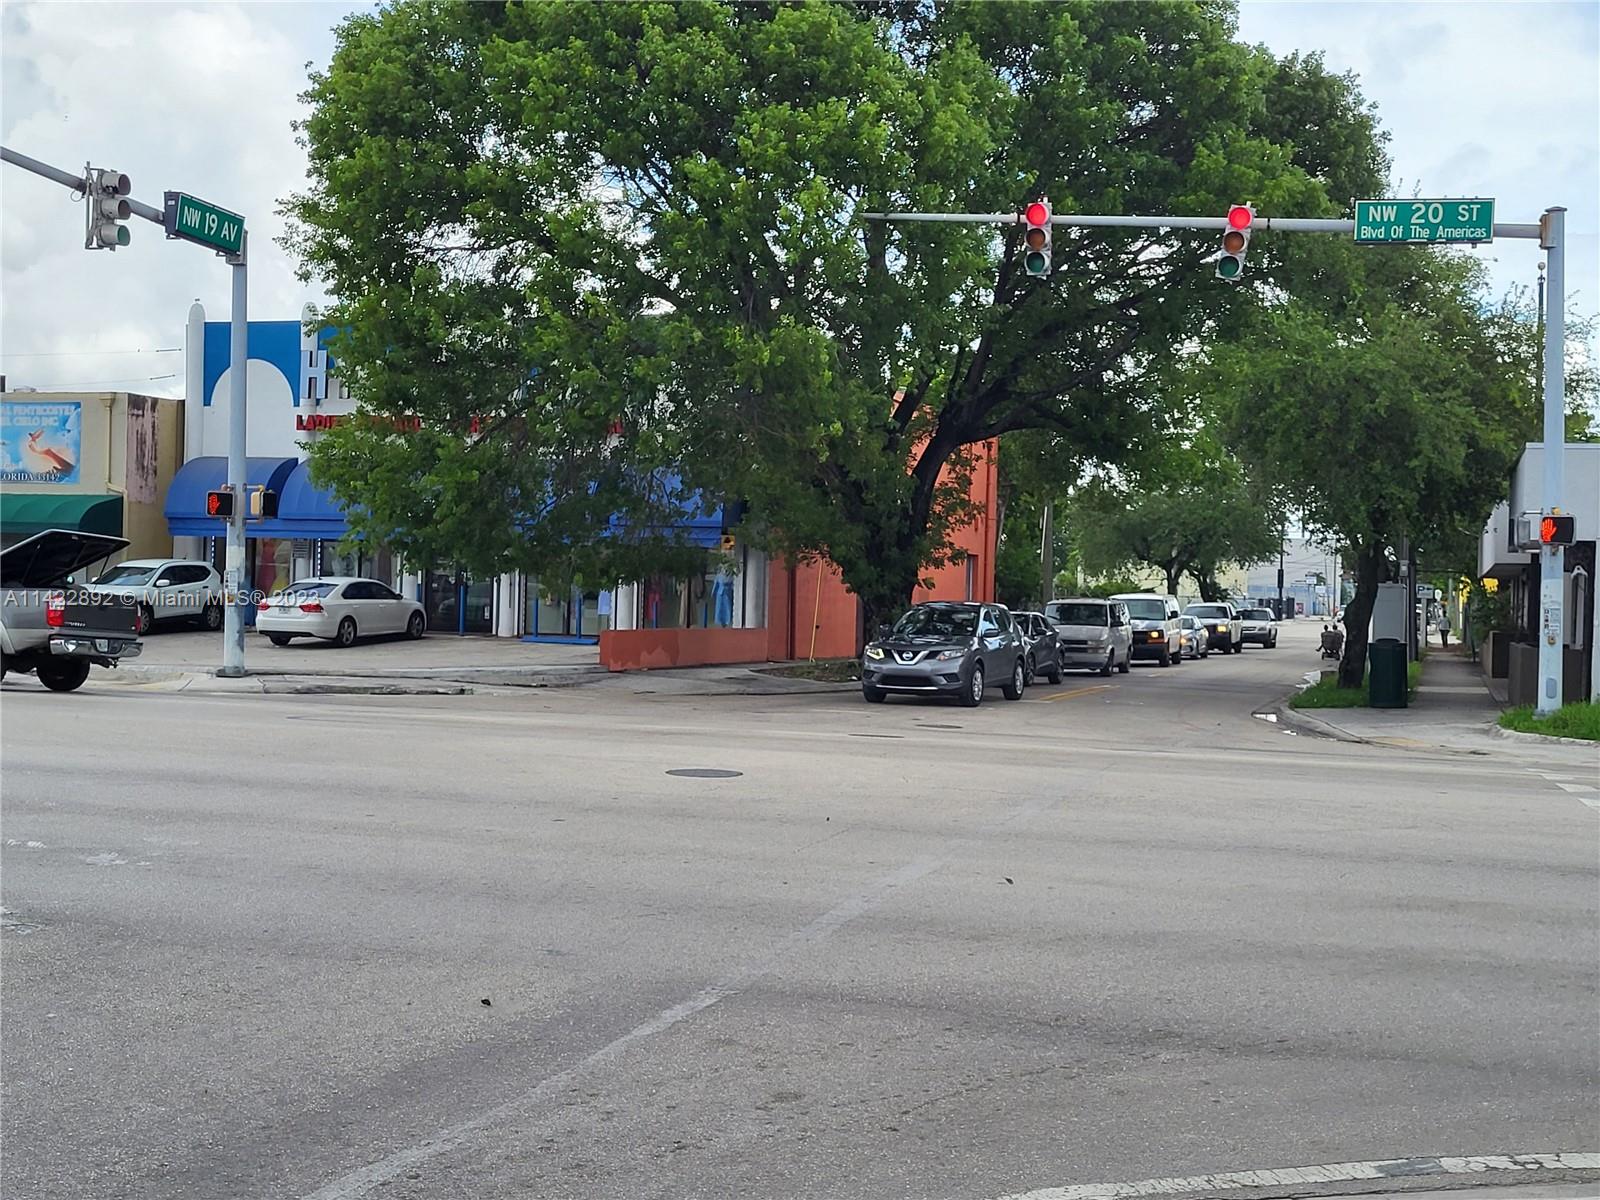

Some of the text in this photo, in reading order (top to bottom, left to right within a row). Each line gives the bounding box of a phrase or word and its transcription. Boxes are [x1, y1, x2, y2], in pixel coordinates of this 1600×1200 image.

[183, 206, 238, 242] NW 19 AV
[1368, 203, 1481, 224] NW 20 ST
[1360, 225, 1487, 239] Blvd Of The Americas
